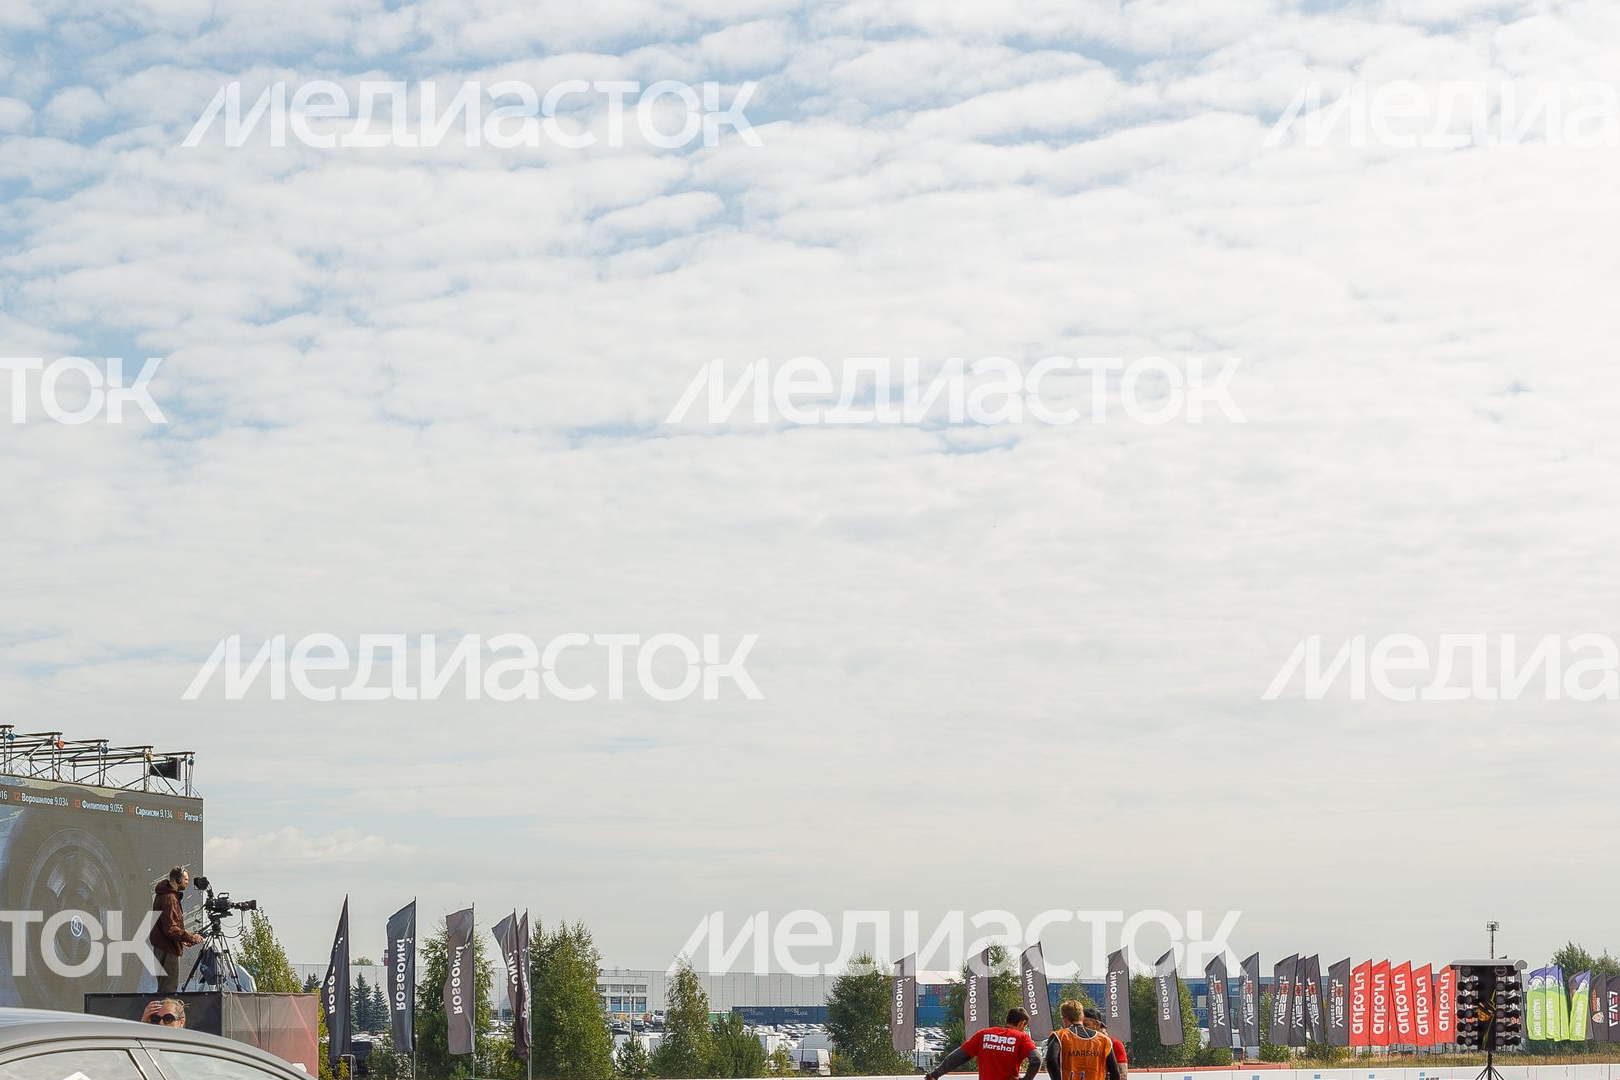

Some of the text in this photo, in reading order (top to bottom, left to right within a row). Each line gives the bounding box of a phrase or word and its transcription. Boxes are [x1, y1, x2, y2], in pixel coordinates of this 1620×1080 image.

[22, 792, 53, 804] Ворошилов
[54, 796, 69, 807] 9.034
[82, 800, 109, 811] Филиппов
[135, 806, 159, 818] Саркисян
[184, 812, 198, 822] Рогов
